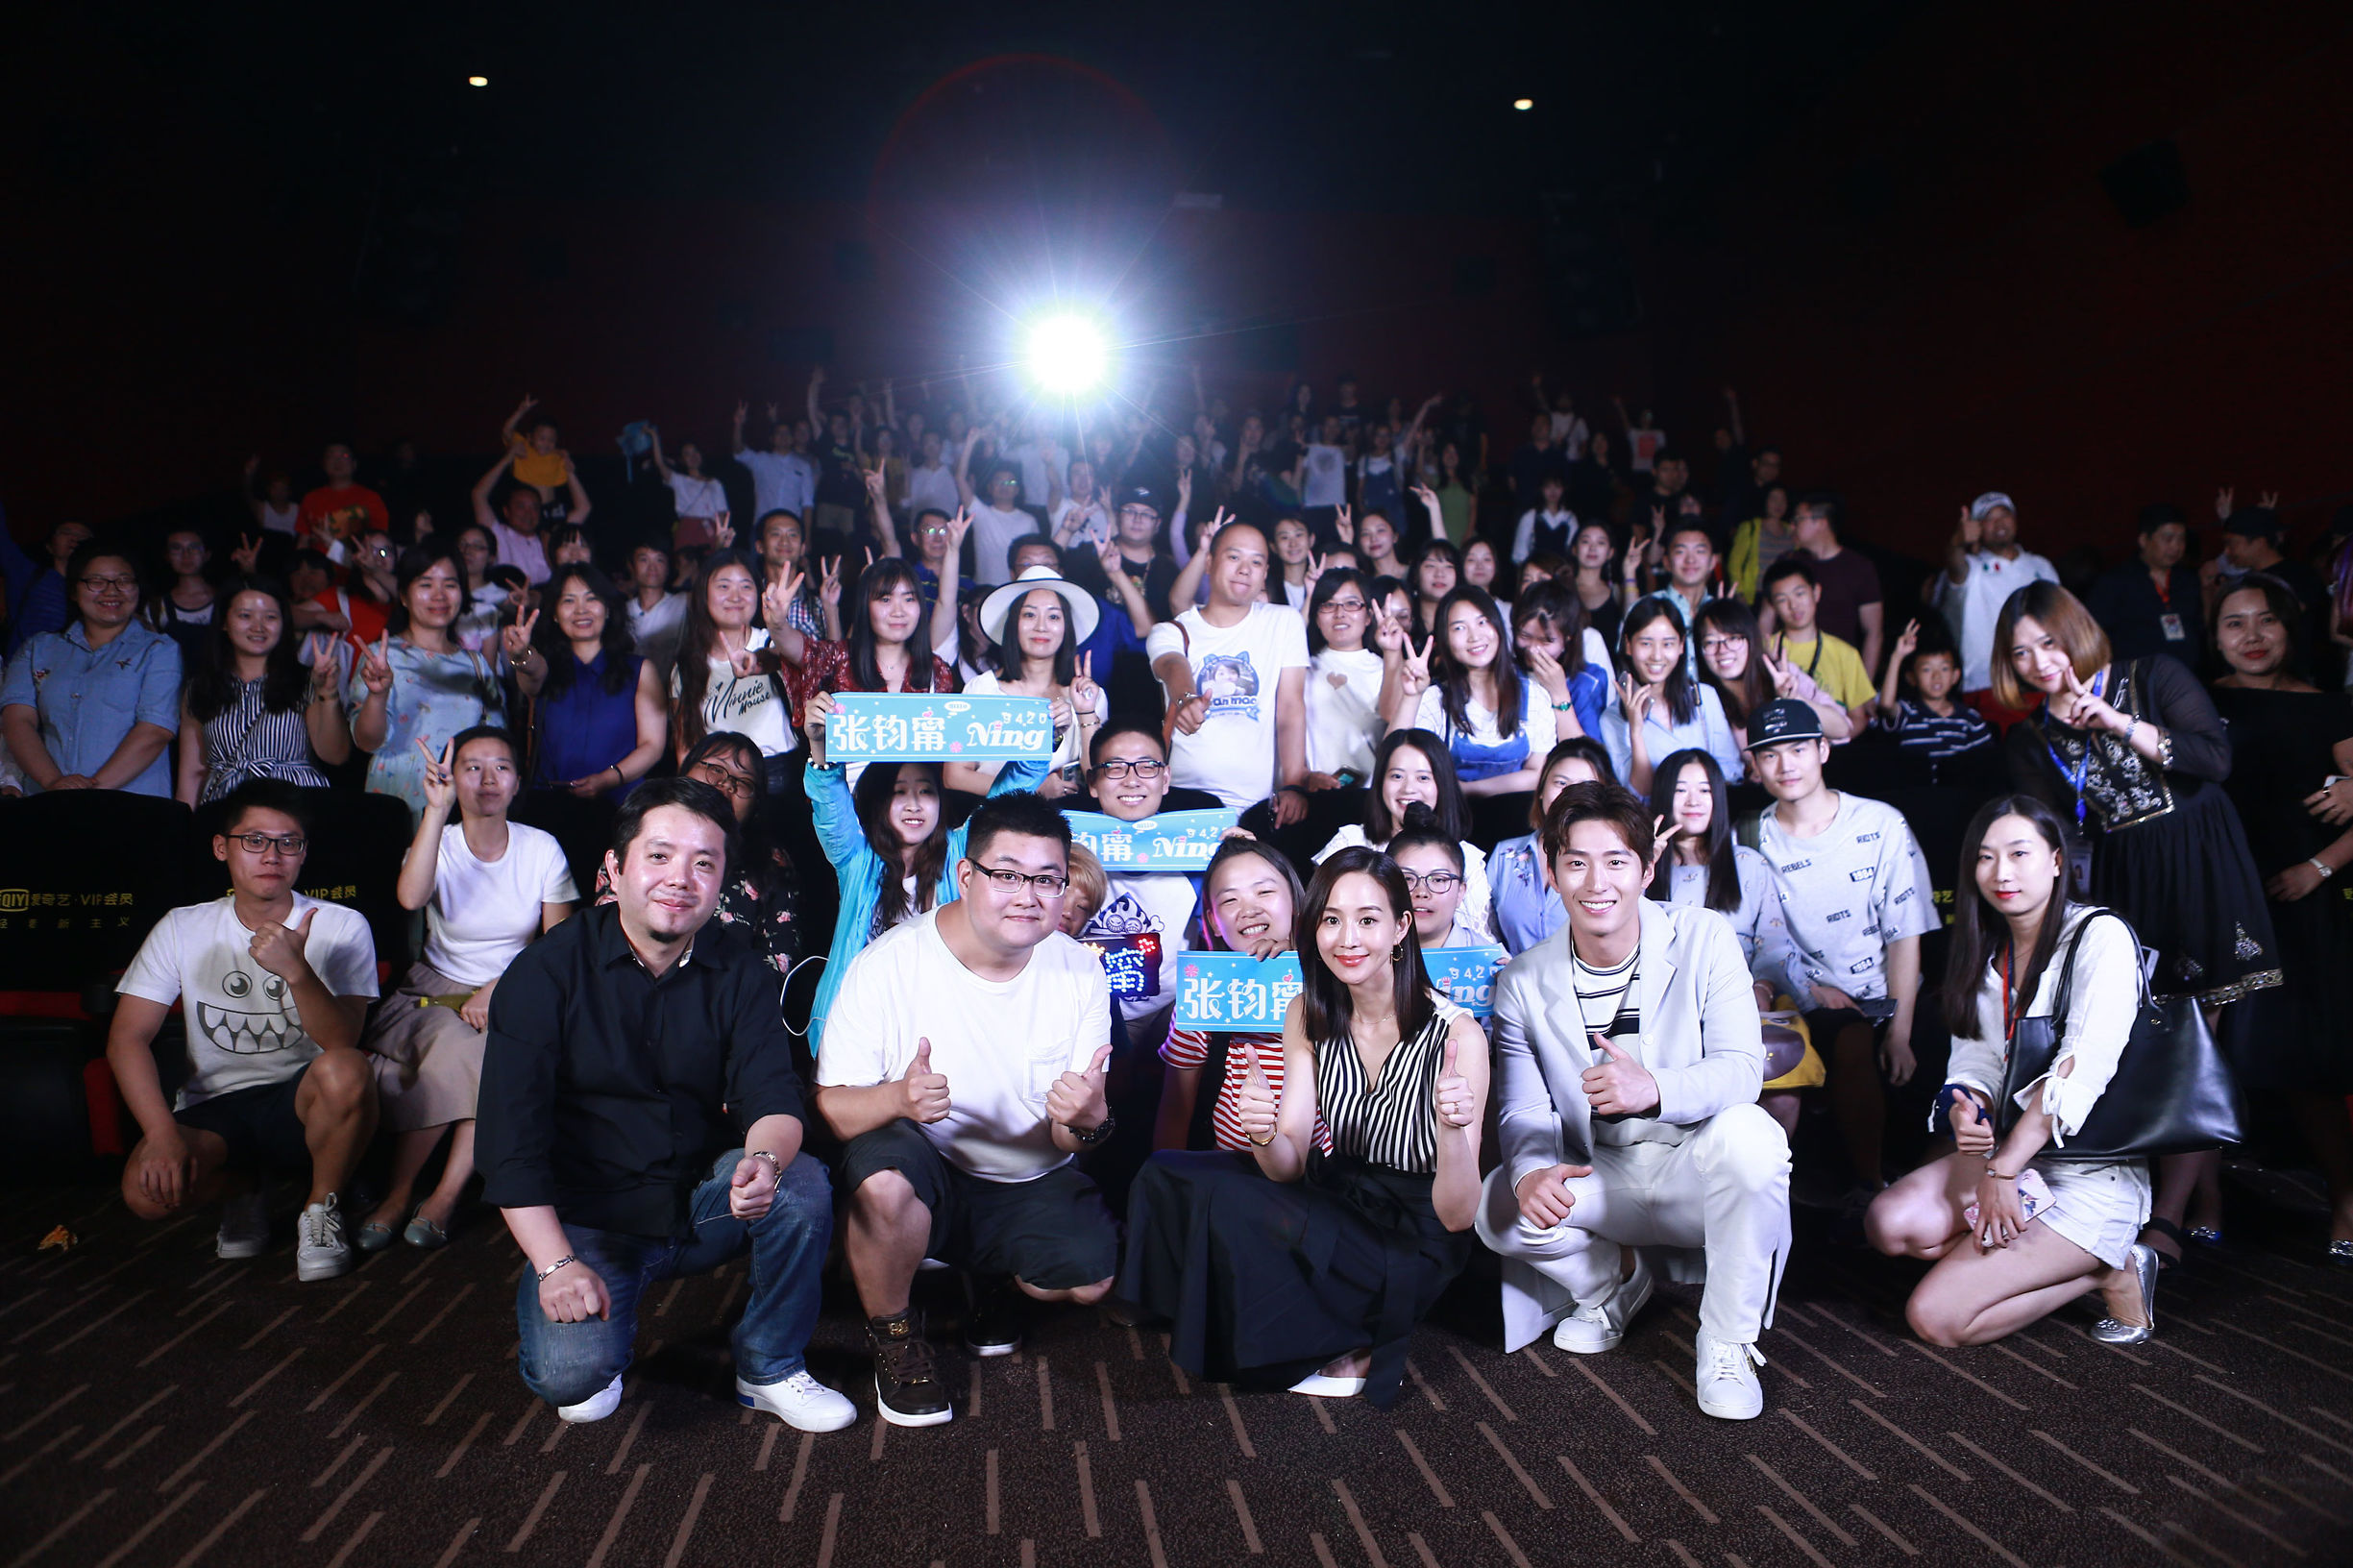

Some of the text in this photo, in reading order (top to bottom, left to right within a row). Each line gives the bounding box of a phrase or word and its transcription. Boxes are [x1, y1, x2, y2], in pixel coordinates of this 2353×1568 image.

[966, 720, 1047, 751] Ning
[1856, 831, 1881, 844] RIOTS
[1781, 858, 1812, 873] REBELS
[1826, 909, 1851, 923] RIOTS
